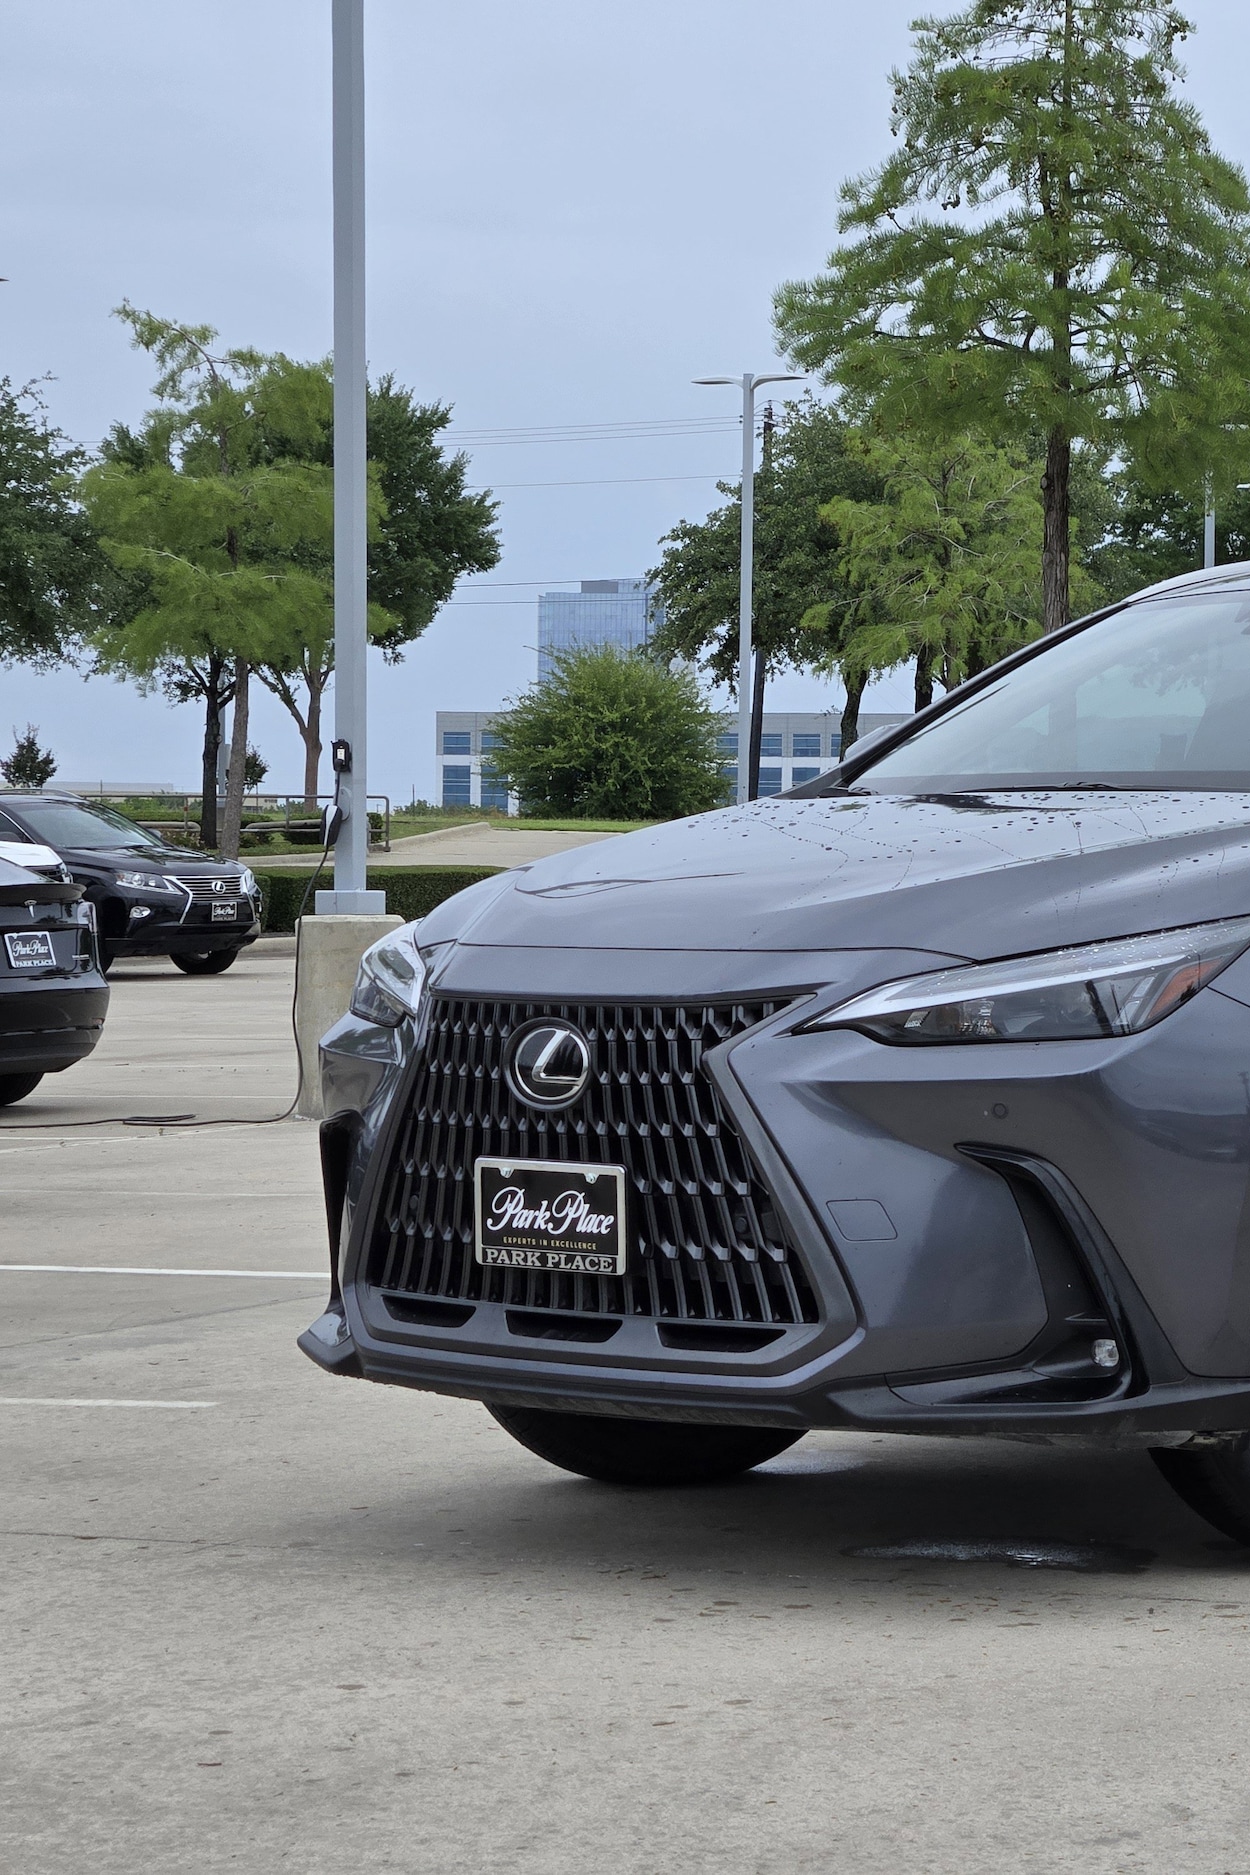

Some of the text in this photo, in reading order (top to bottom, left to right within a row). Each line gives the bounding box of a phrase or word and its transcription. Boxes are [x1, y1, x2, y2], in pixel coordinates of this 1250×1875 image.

[486, 1186, 615, 1235] Park Place
[503, 1236, 597, 1250] EXPERTS IN EXCELLENCE
[485, 1249, 613, 1272] PARK PLACE
